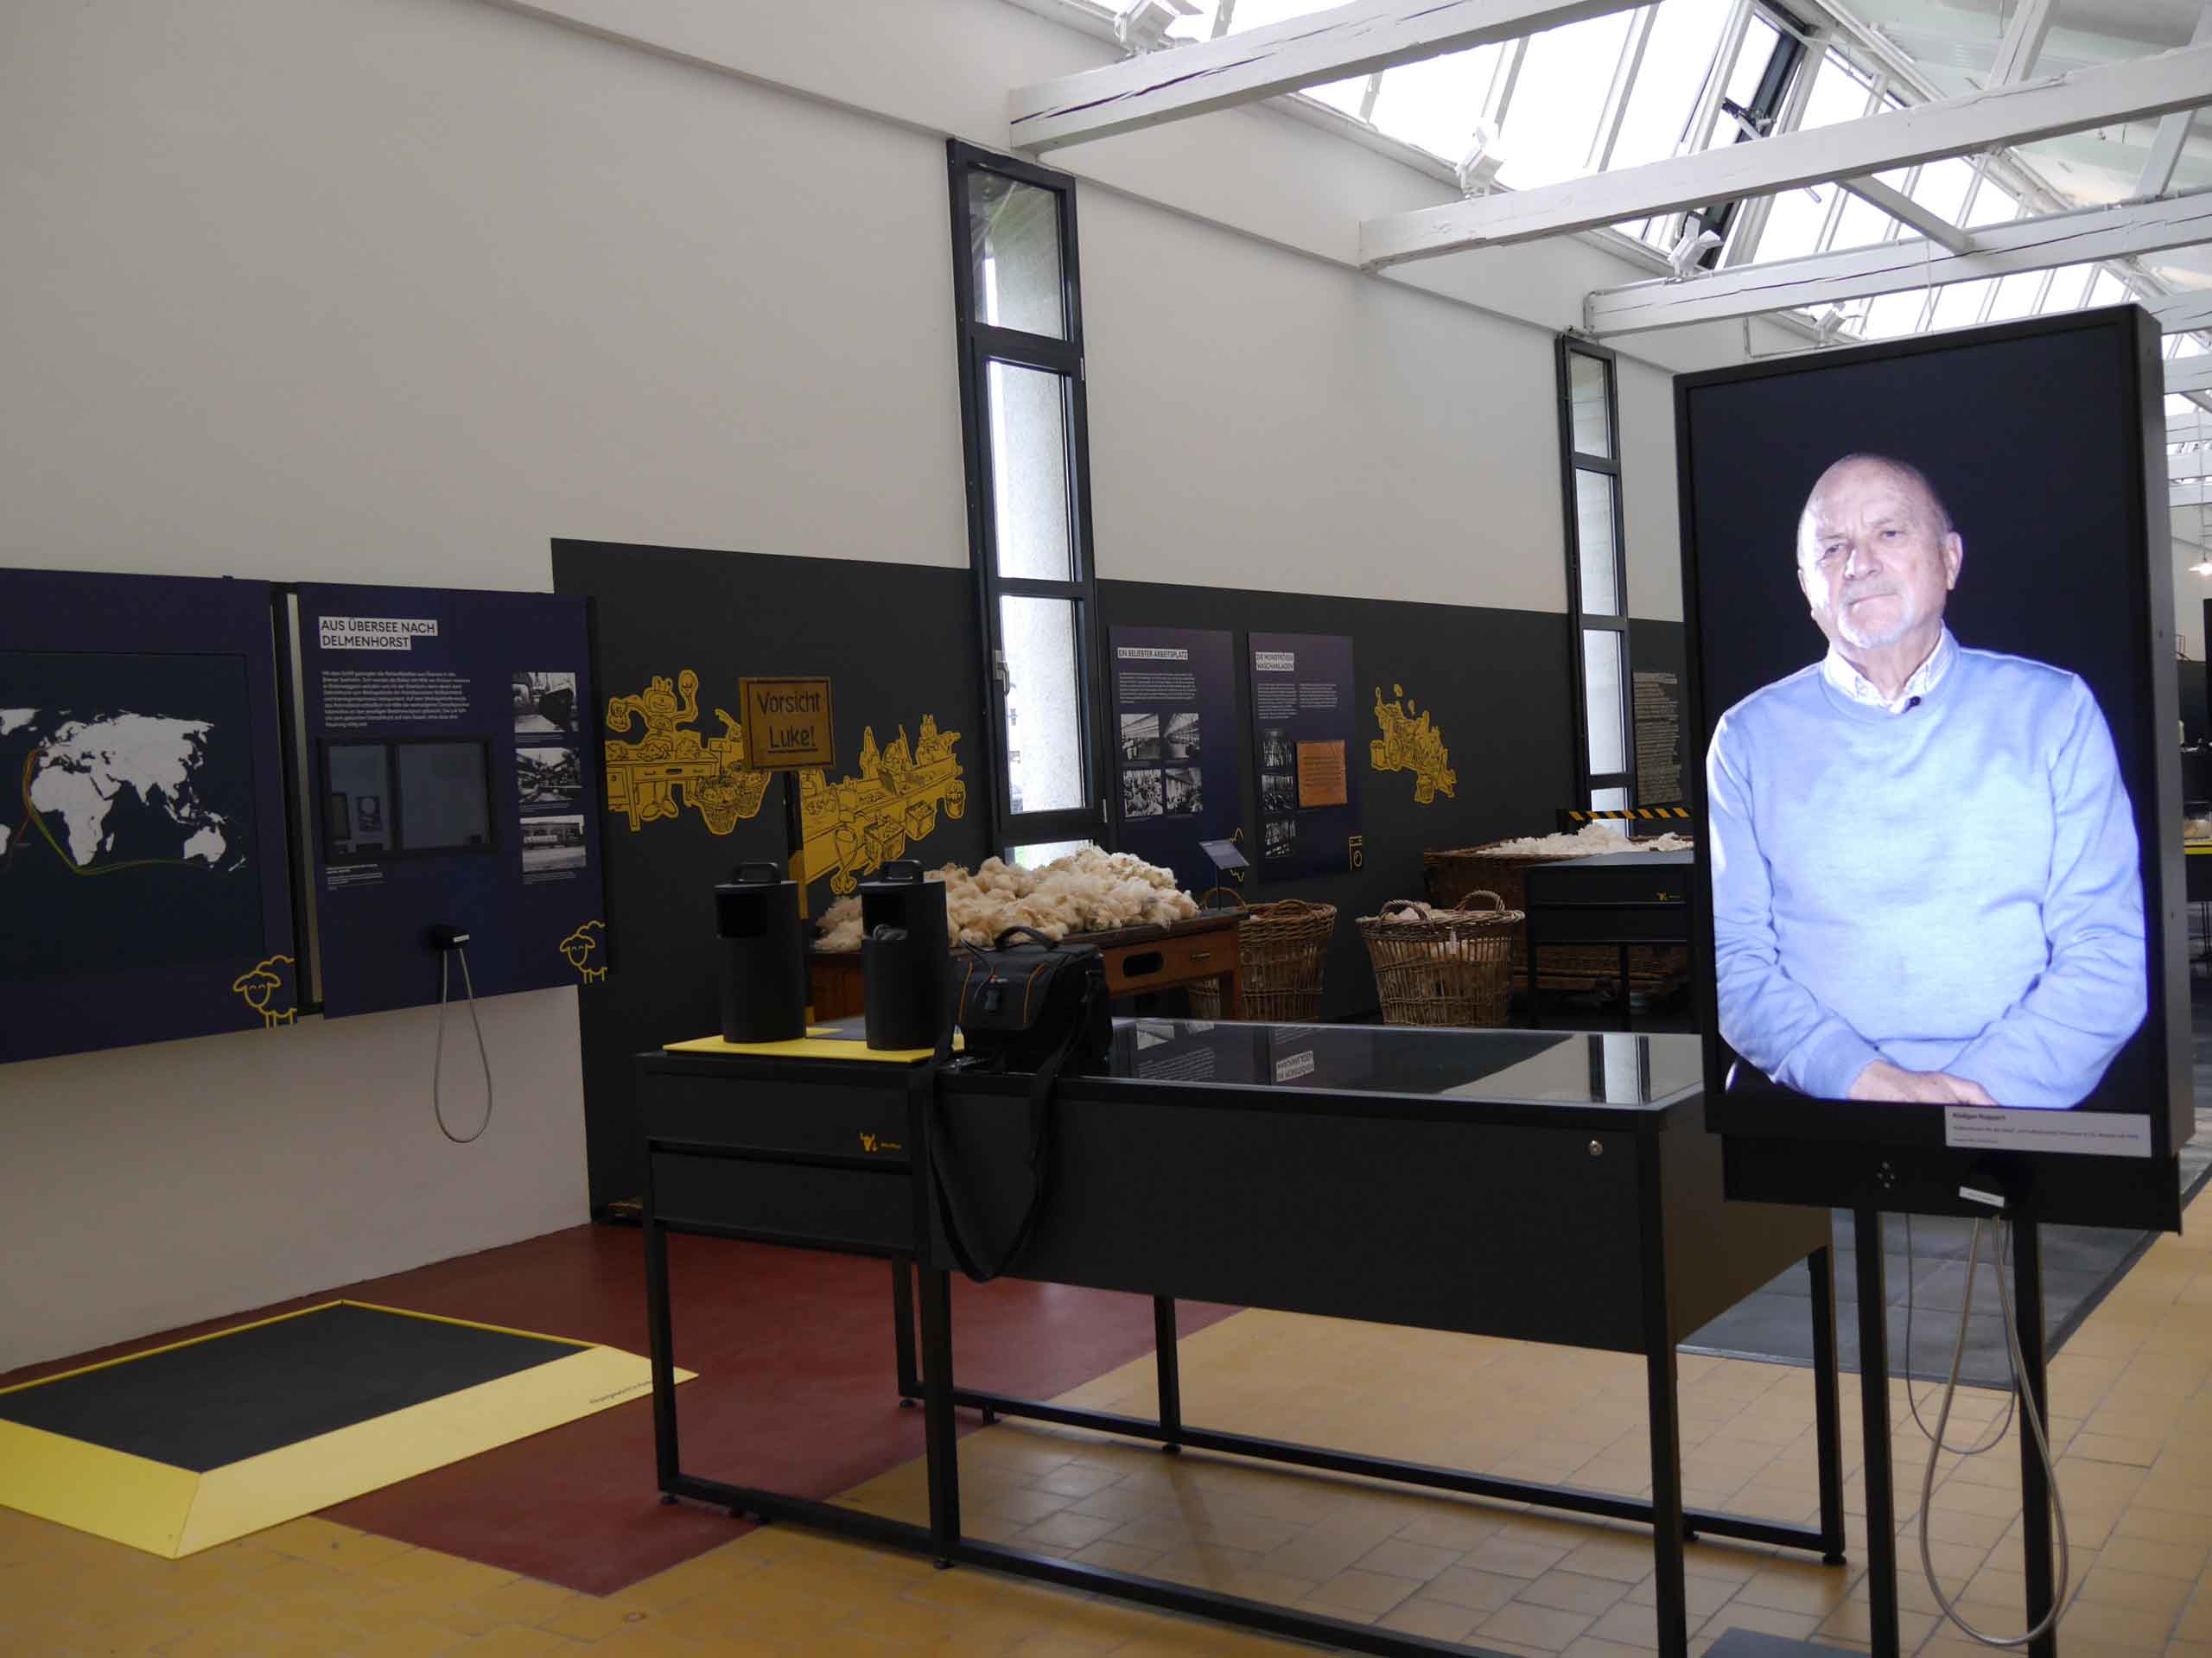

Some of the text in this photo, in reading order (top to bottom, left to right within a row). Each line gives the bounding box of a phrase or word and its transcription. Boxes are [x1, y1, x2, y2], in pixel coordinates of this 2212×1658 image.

[321, 618, 435, 633] AUS ÜBERSEE NACH
[322, 635, 409, 647] DELMENHORST
[757, 690, 820, 715] Vorsicht
[769, 725, 816, 747] Luke!
